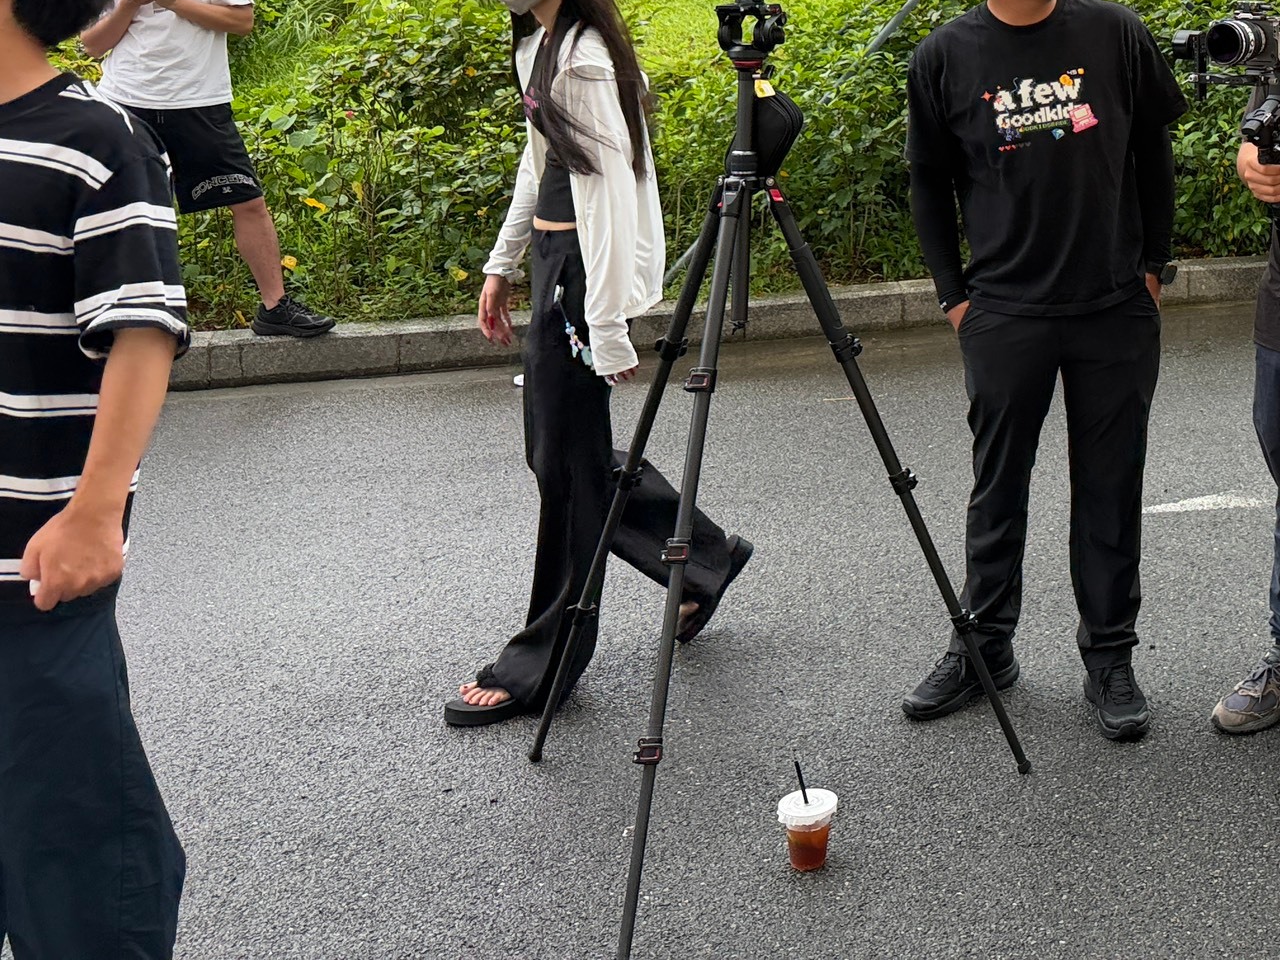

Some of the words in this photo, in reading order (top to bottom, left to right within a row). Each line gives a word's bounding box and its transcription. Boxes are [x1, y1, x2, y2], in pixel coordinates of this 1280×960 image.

[994, 90, 1017, 112] a
[1018, 78, 1081, 108] few
[996, 102, 1084, 129] Goodkid
